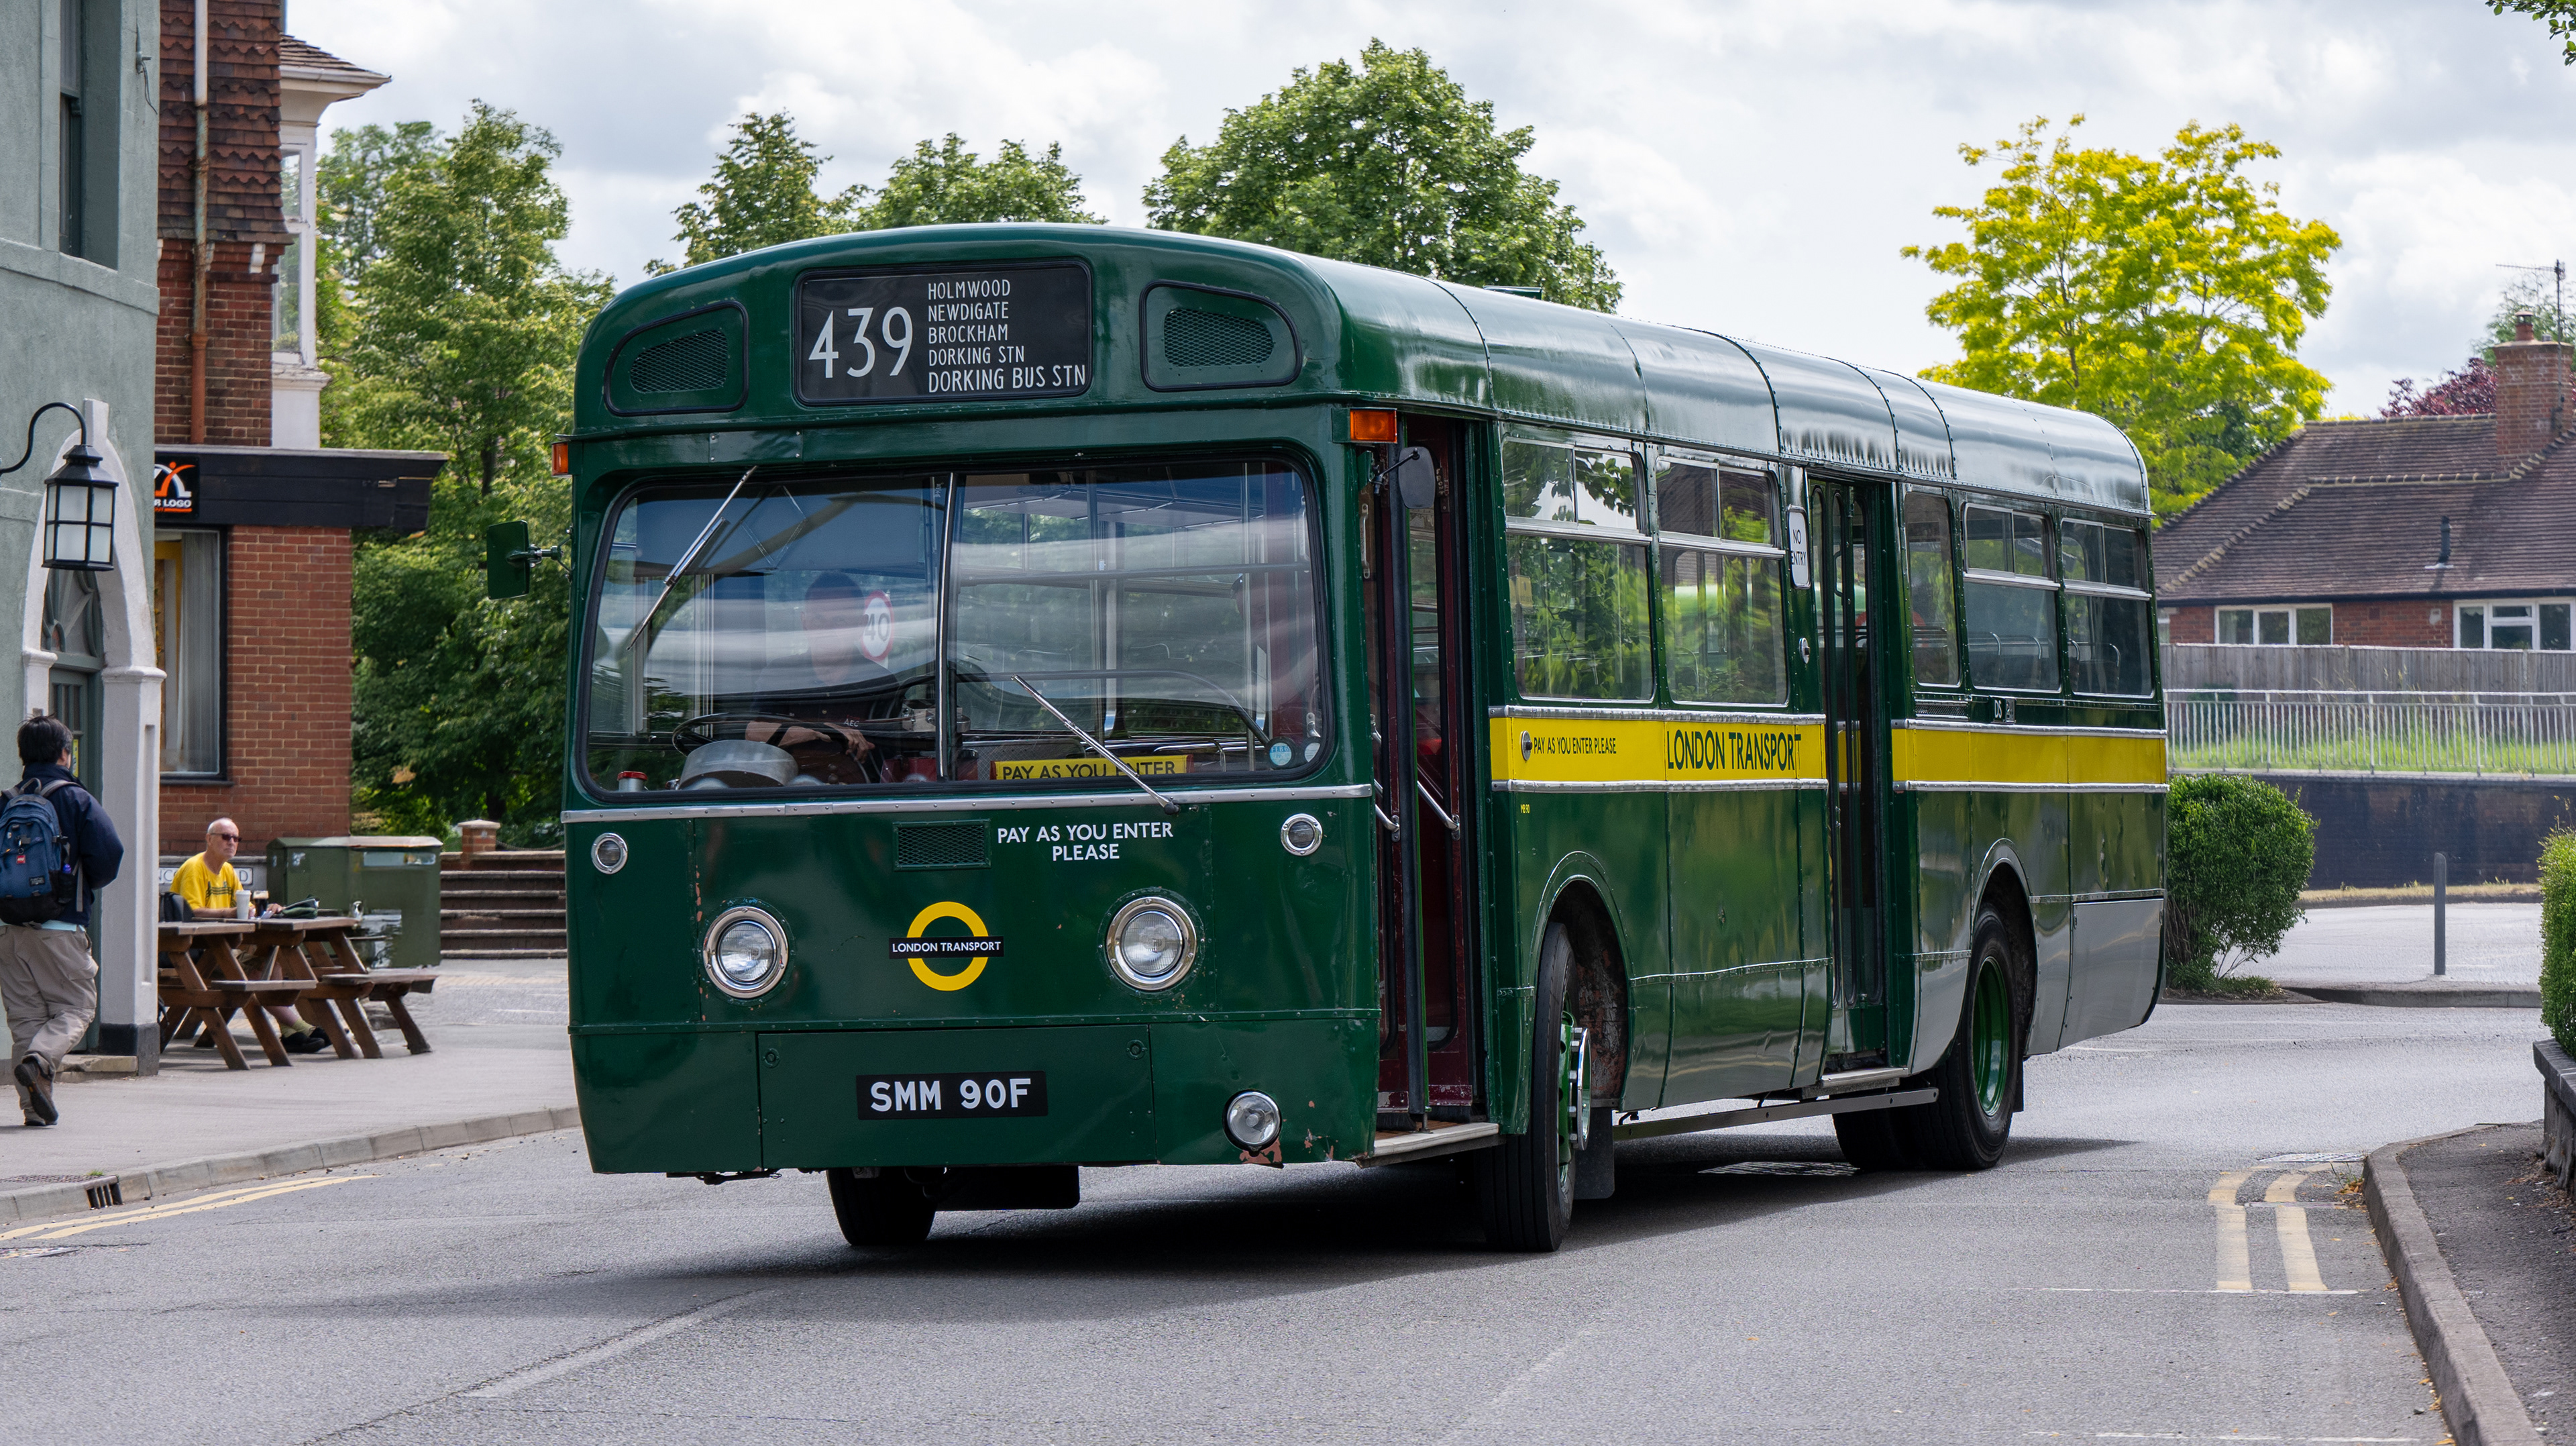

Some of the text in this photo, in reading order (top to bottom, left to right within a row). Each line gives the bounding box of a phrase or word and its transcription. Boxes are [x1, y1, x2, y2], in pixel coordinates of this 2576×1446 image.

[928, 280, 1011, 300] HOLMWOOD
[928, 302, 1009, 322] NEWDIGATE
[808, 307, 913, 378] 439
[928, 324, 1008, 344] BROCKHAM
[928, 346, 1024, 366] DORKING STN
[928, 364, 1086, 393] DORKING BUS STN
[163, 499, 192, 508] LOGO
[1793, 529, 1801, 544] NO
[1790, 550, 1807, 566] ENTRY
[864, 612, 890, 641] 40
[1994, 699, 2002, 719] DS
[844, 719, 859, 727] AEC
[1534, 737, 1617, 755] PAY AS YOU ENTER PLEASE
[1667, 729, 1802, 771] LONDON TRANSPORT
[1002, 761, 1175, 780] PAY AS YOU ENTER
[998, 822, 1174, 843] PAY AS YOU ENTER
[1053, 843, 1120, 862] PLEASE
[892, 941, 1002, 953] LONDON TRANSPORT
[871, 1078, 1031, 1112] SMM 90F
